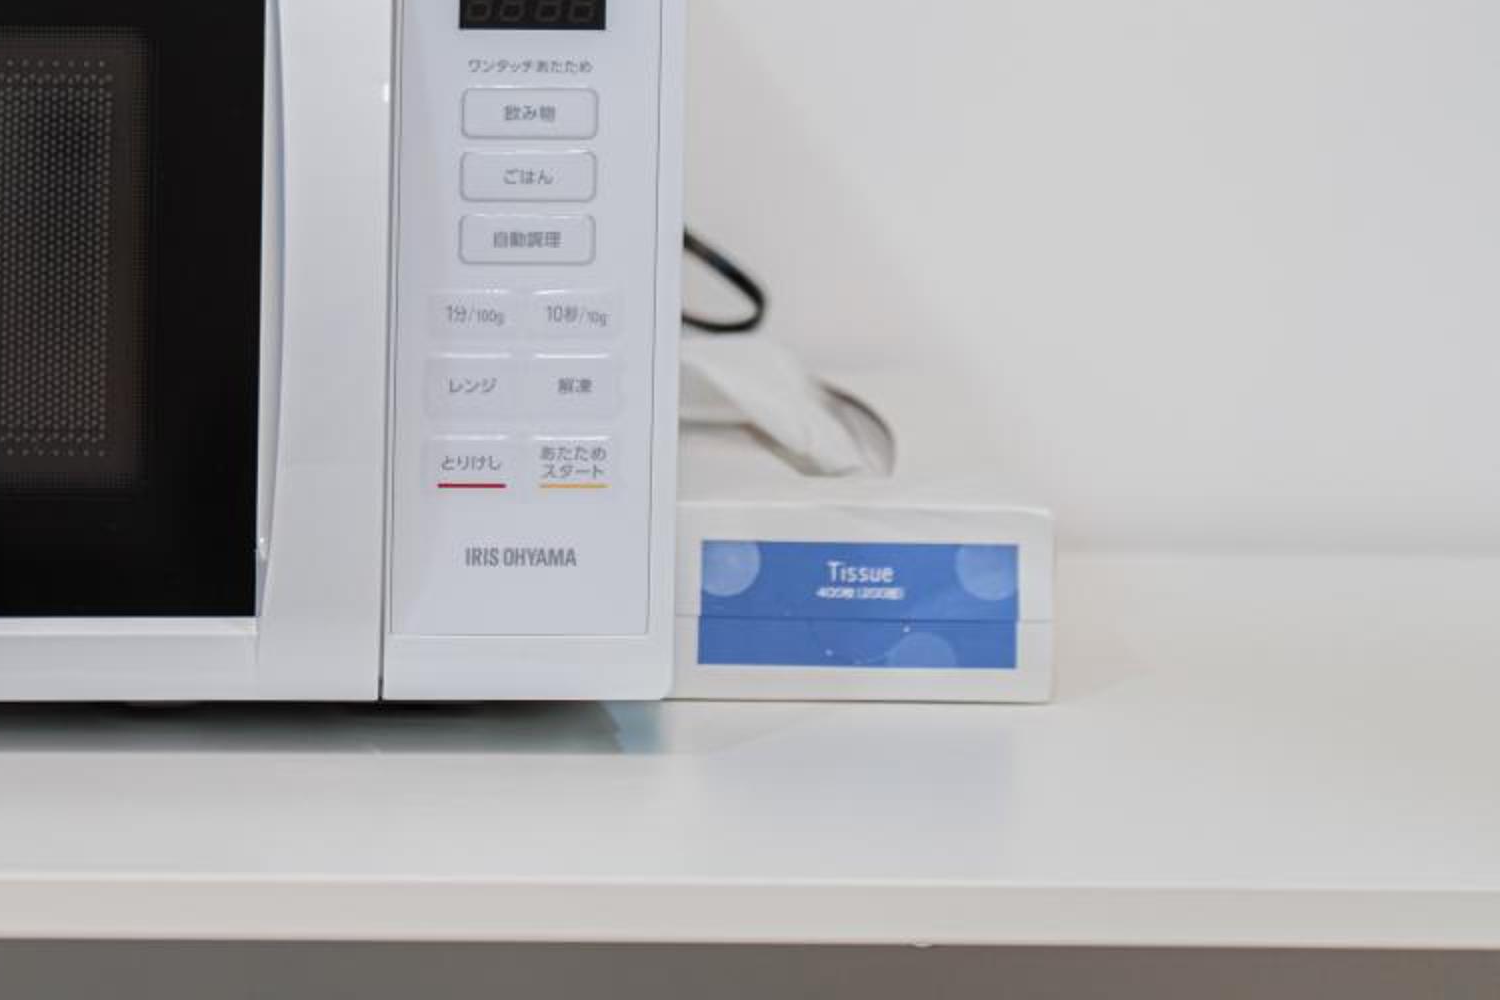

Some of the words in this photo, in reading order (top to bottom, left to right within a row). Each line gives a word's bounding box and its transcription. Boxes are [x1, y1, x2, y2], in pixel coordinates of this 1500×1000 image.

[504, 104, 556, 122] 飲み物
[503, 168, 554, 186] ごはん
[493, 230, 561, 249] 自動調理
[449, 377, 498, 393] レンジ
[440, 455, 501, 471] とりけし
[540, 446, 607, 462] あたため
[540, 463, 606, 479] スタート
[465, 547, 500, 567] IRIS
[503, 547, 577, 567] OHYAMA
[826, 560, 894, 583] Tissue
